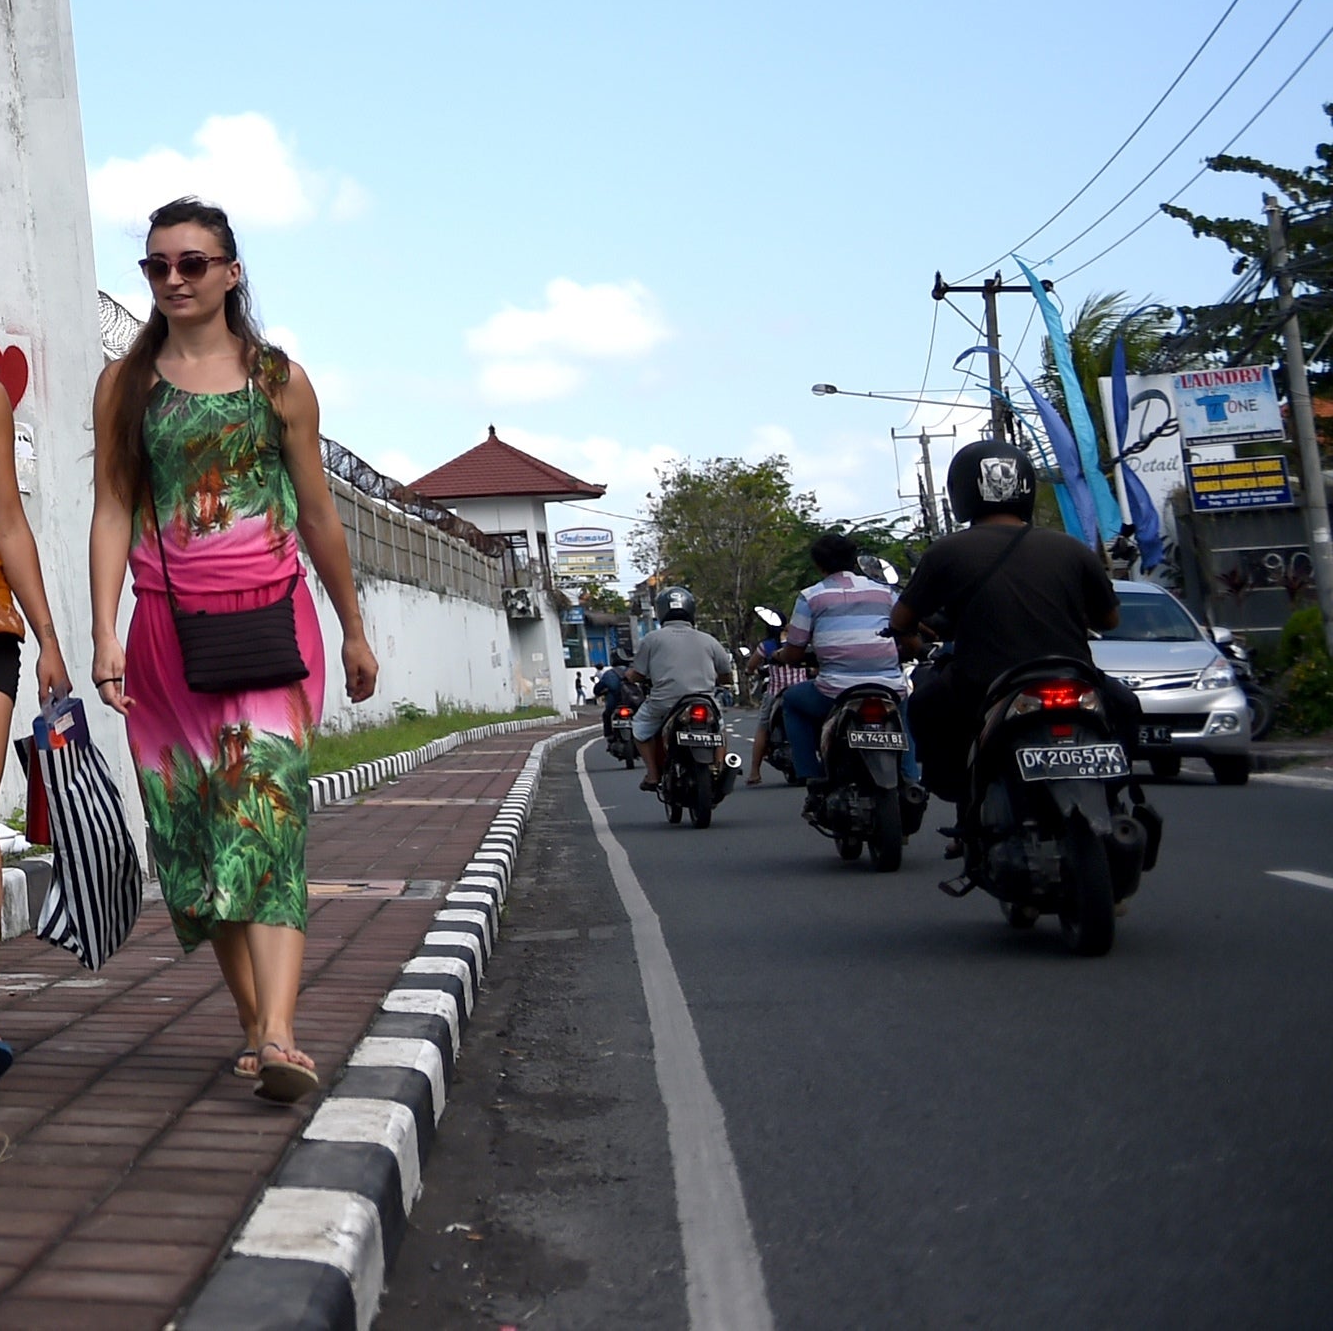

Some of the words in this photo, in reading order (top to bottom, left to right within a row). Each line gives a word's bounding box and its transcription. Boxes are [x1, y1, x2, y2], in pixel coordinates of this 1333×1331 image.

[1180, 367, 1262, 388] LAUNDRY
[1123, 455, 1179, 472] Detail
[850, 733, 864, 742] DK
[866, 734, 889, 743] 7421
[1022, 751, 1046, 768] DK
[1047, 749, 1094, 765] 2065
[1095, 747, 1120, 763] FK
